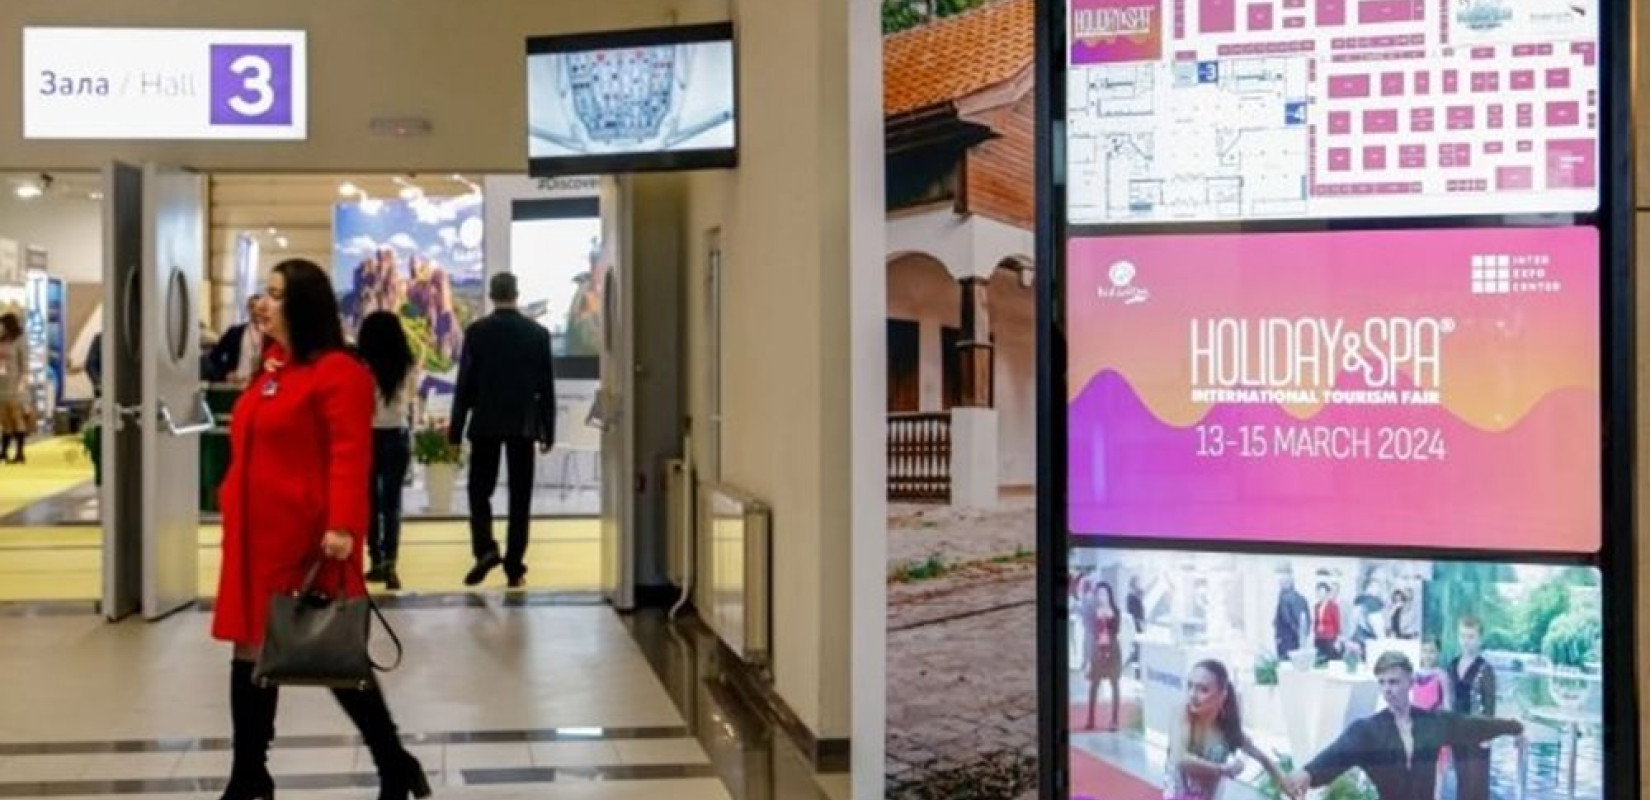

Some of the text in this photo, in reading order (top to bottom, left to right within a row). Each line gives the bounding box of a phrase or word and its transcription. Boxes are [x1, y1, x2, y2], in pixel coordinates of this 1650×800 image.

[38, 70, 110, 96] Зала
[140, 70, 197, 97] Hall
[227, 54, 275, 117] 3
[1512, 269, 1546, 279] EXPO
[1191, 389, 1440, 404] INTERNATIONAL TOURISM FAIR
[1195, 424, 1446, 460] 13-15 MARCH 2024
